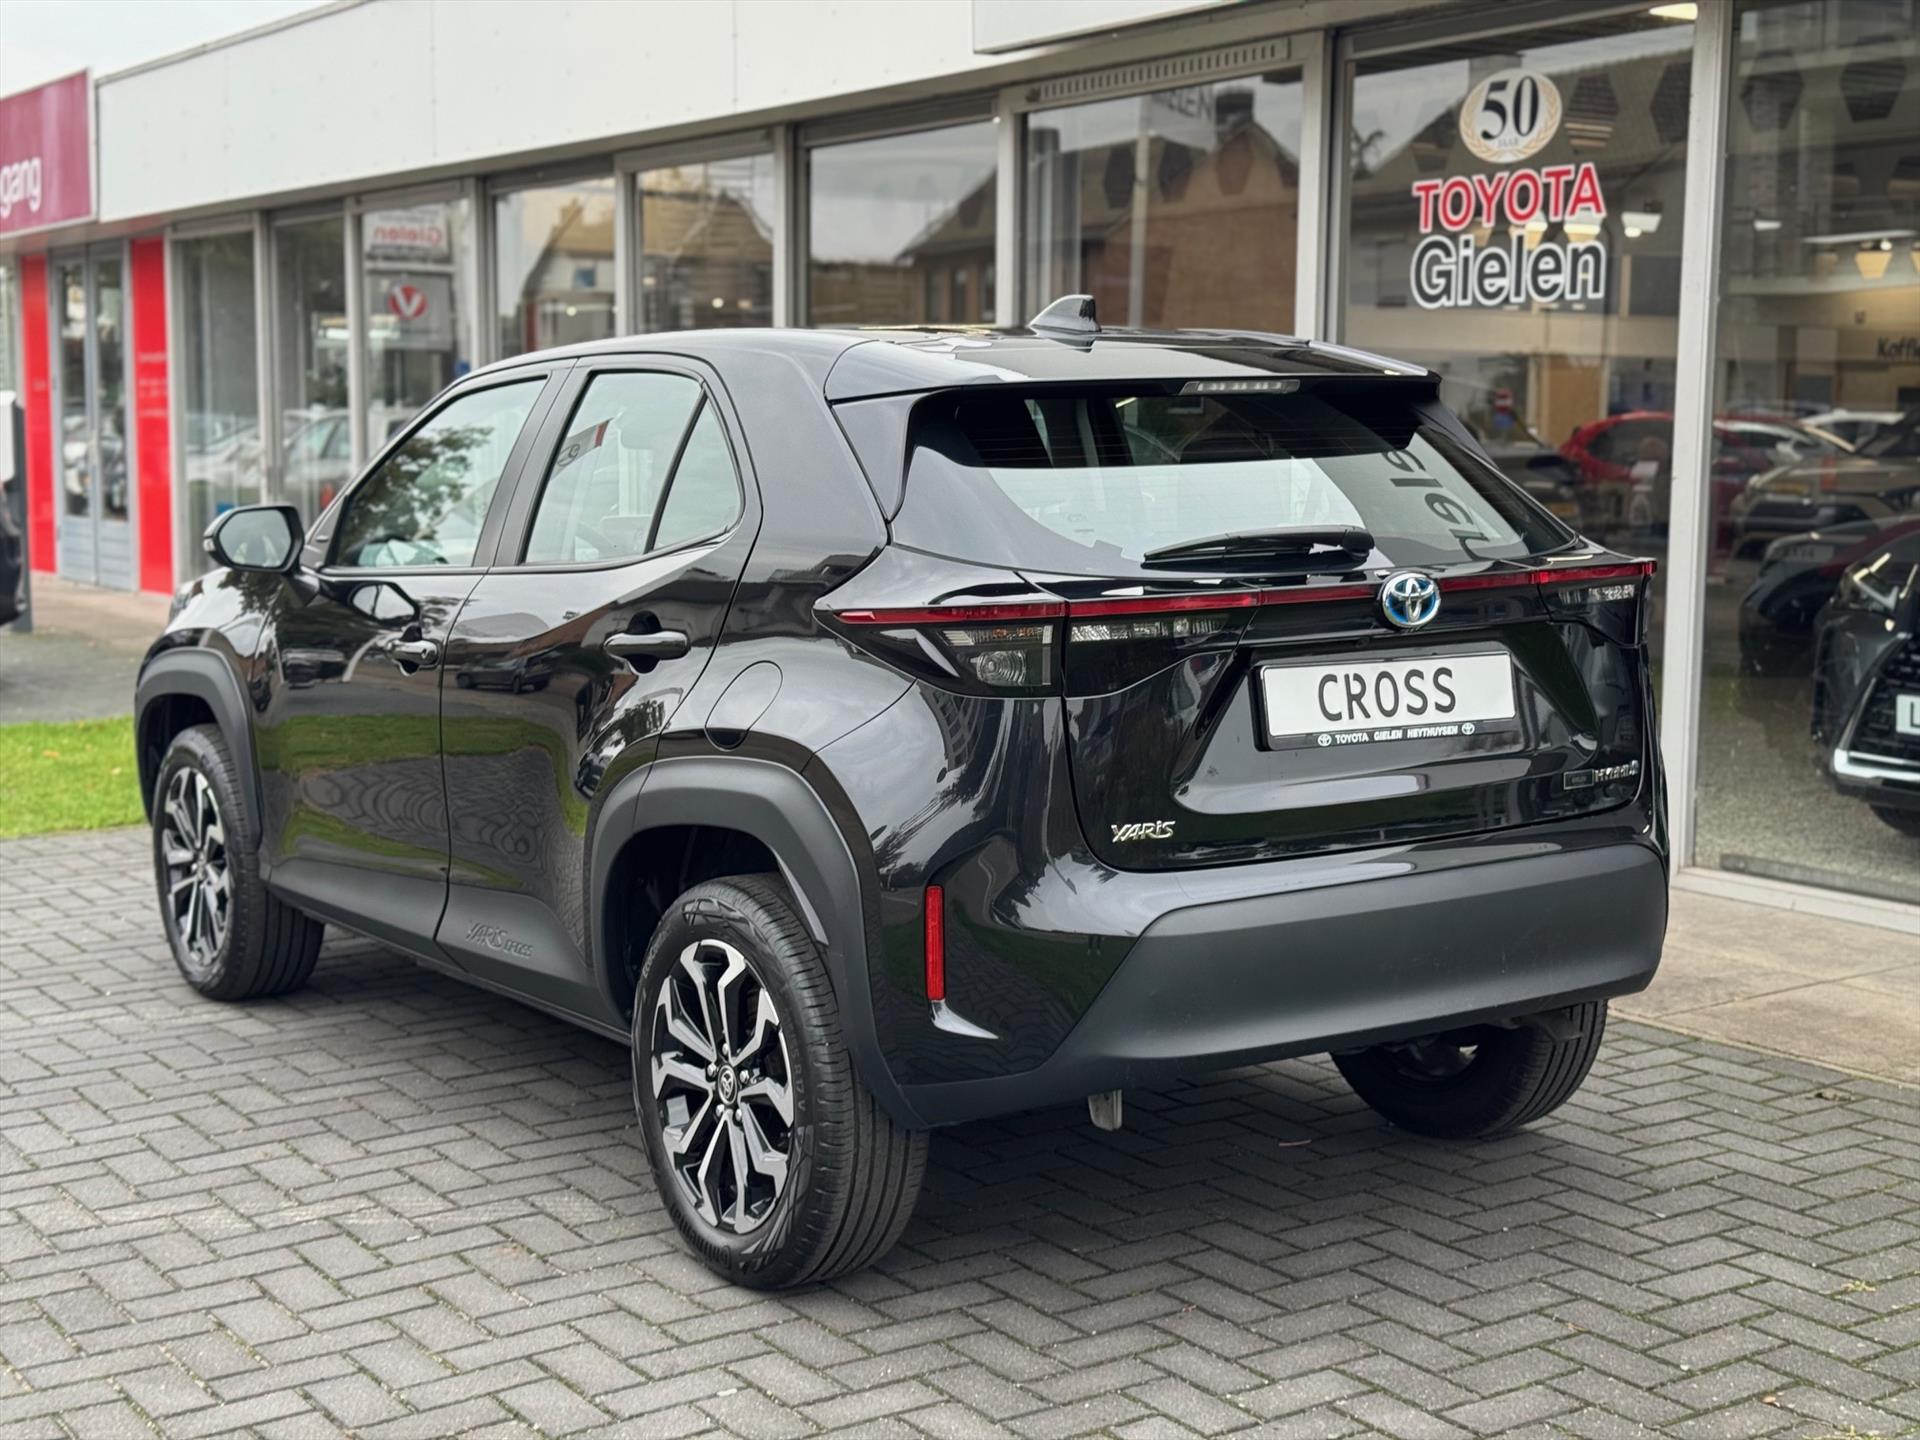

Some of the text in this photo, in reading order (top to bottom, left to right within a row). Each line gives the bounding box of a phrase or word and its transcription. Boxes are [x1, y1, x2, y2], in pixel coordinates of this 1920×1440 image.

[1481, 76, 1539, 140] 50
[0, 157, 42, 218] gang
[1412, 163, 1606, 233] TOYOTA
[1411, 233, 1606, 309] Gielen
[1318, 667, 1456, 721] CROSS
[1335, 725, 1459, 745] TOYOTA GIELEN HEYTHUYSEN
